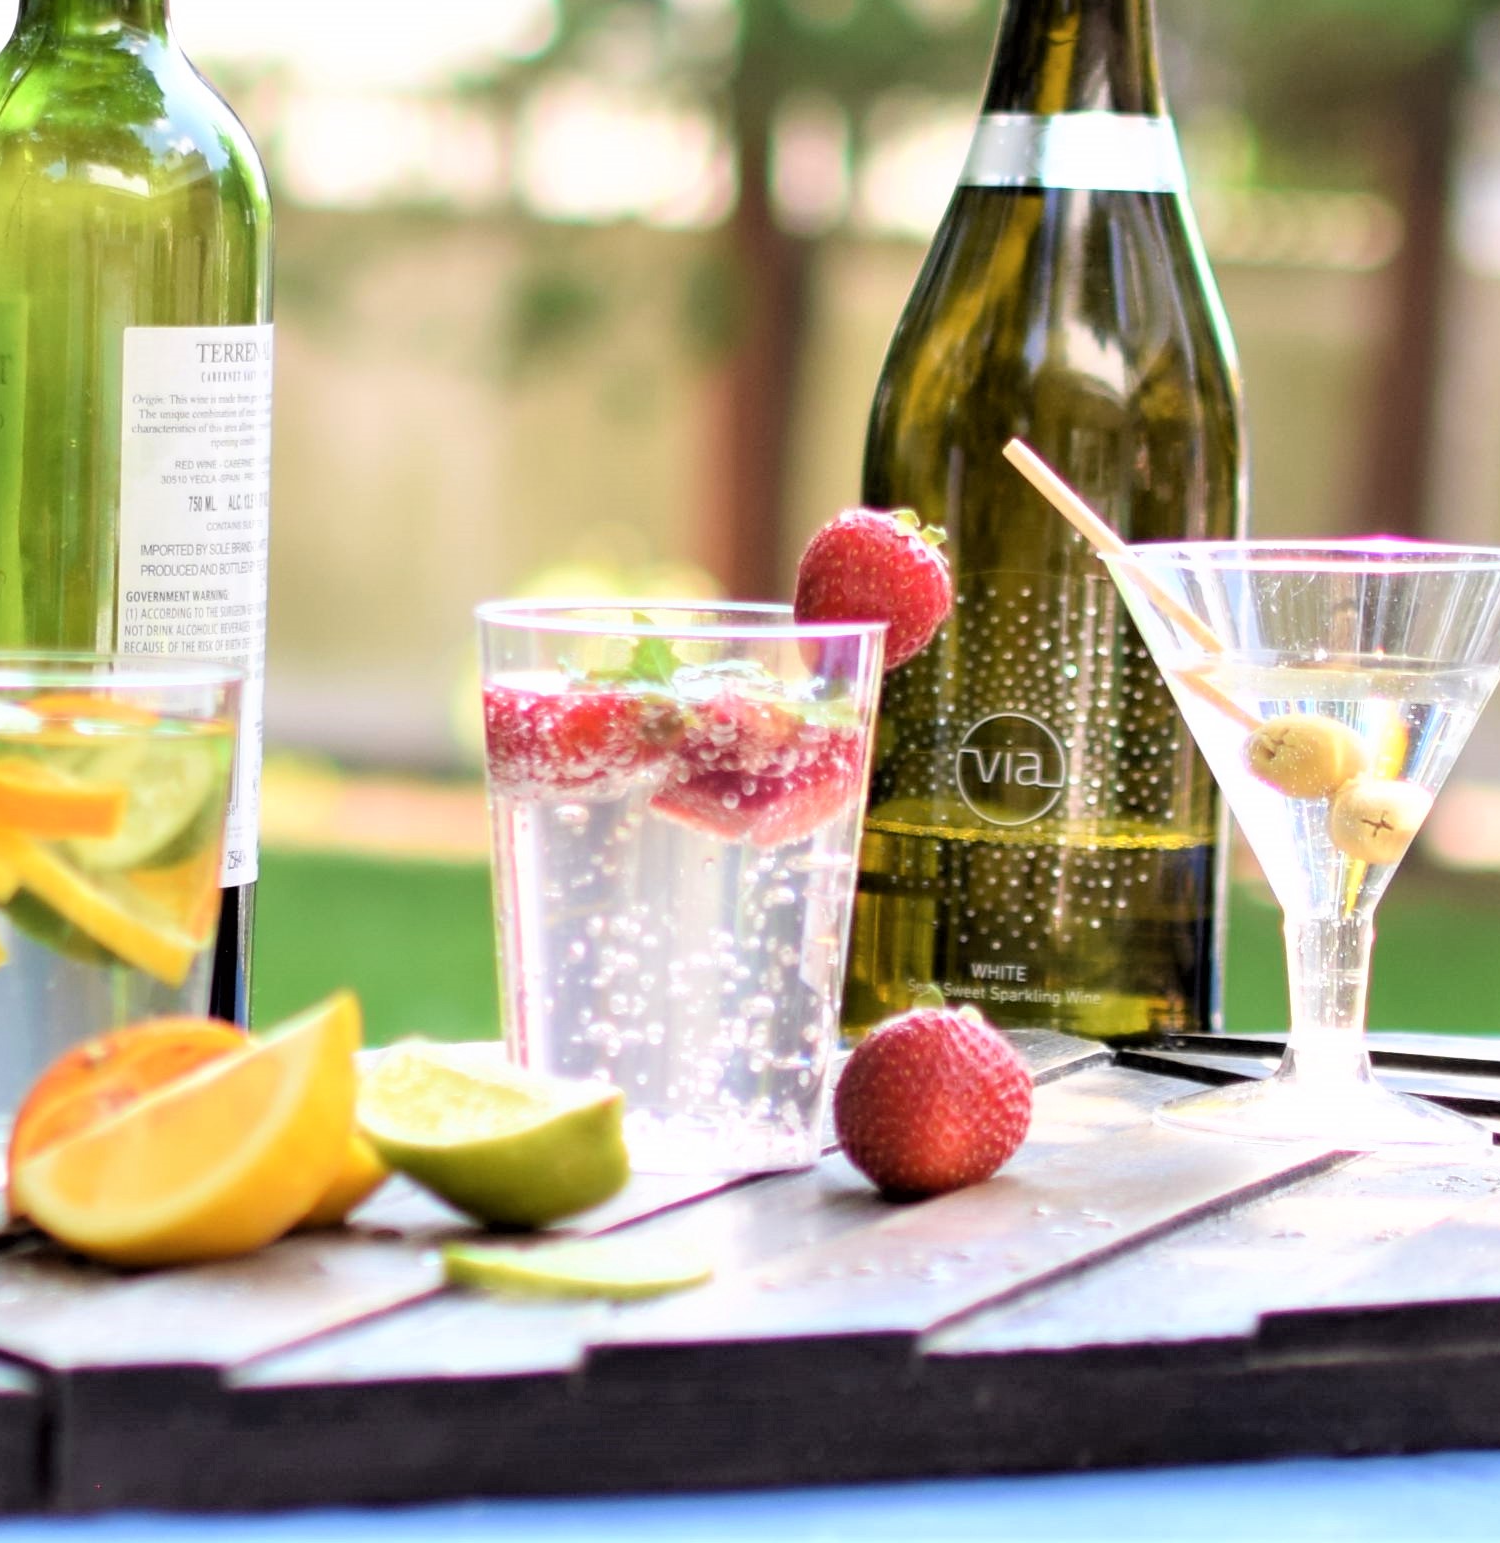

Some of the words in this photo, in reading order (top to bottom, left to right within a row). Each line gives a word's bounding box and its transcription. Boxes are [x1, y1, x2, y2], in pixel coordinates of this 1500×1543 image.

[138, 409, 156, 419] The
[175, 460, 194, 470] RED
[196, 459, 217, 469] WINE
[188, 496, 203, 512] 750
[140, 544, 194, 557] IMPORTED
[196, 543, 207, 556] BY
[140, 564, 198, 577] PRODUCED
[200, 563, 218, 576] AND
[126, 590, 190, 603] GOVERNMENT
[125, 608, 138, 621] (1)
[140, 607, 192, 620] ACCORDING
[194, 607, 204, 619] TO
[206, 606, 219, 618] THE
[124, 624, 143, 637] NOT
[146, 624, 173, 636] DRINK
[176, 623, 218, 636] ALCOHOLIC
[124, 641, 165, 654] BECAUSE
[168, 641, 179, 653] OF
[182, 641, 195, 653] THE
[197, 640, 213, 652] RISK
[970, 963, 1028, 983] WHITE
[943, 982, 986, 1000] Sweet
[990, 986, 1061, 1007] Sparkling
[1066, 991, 1101, 1005] Wine
